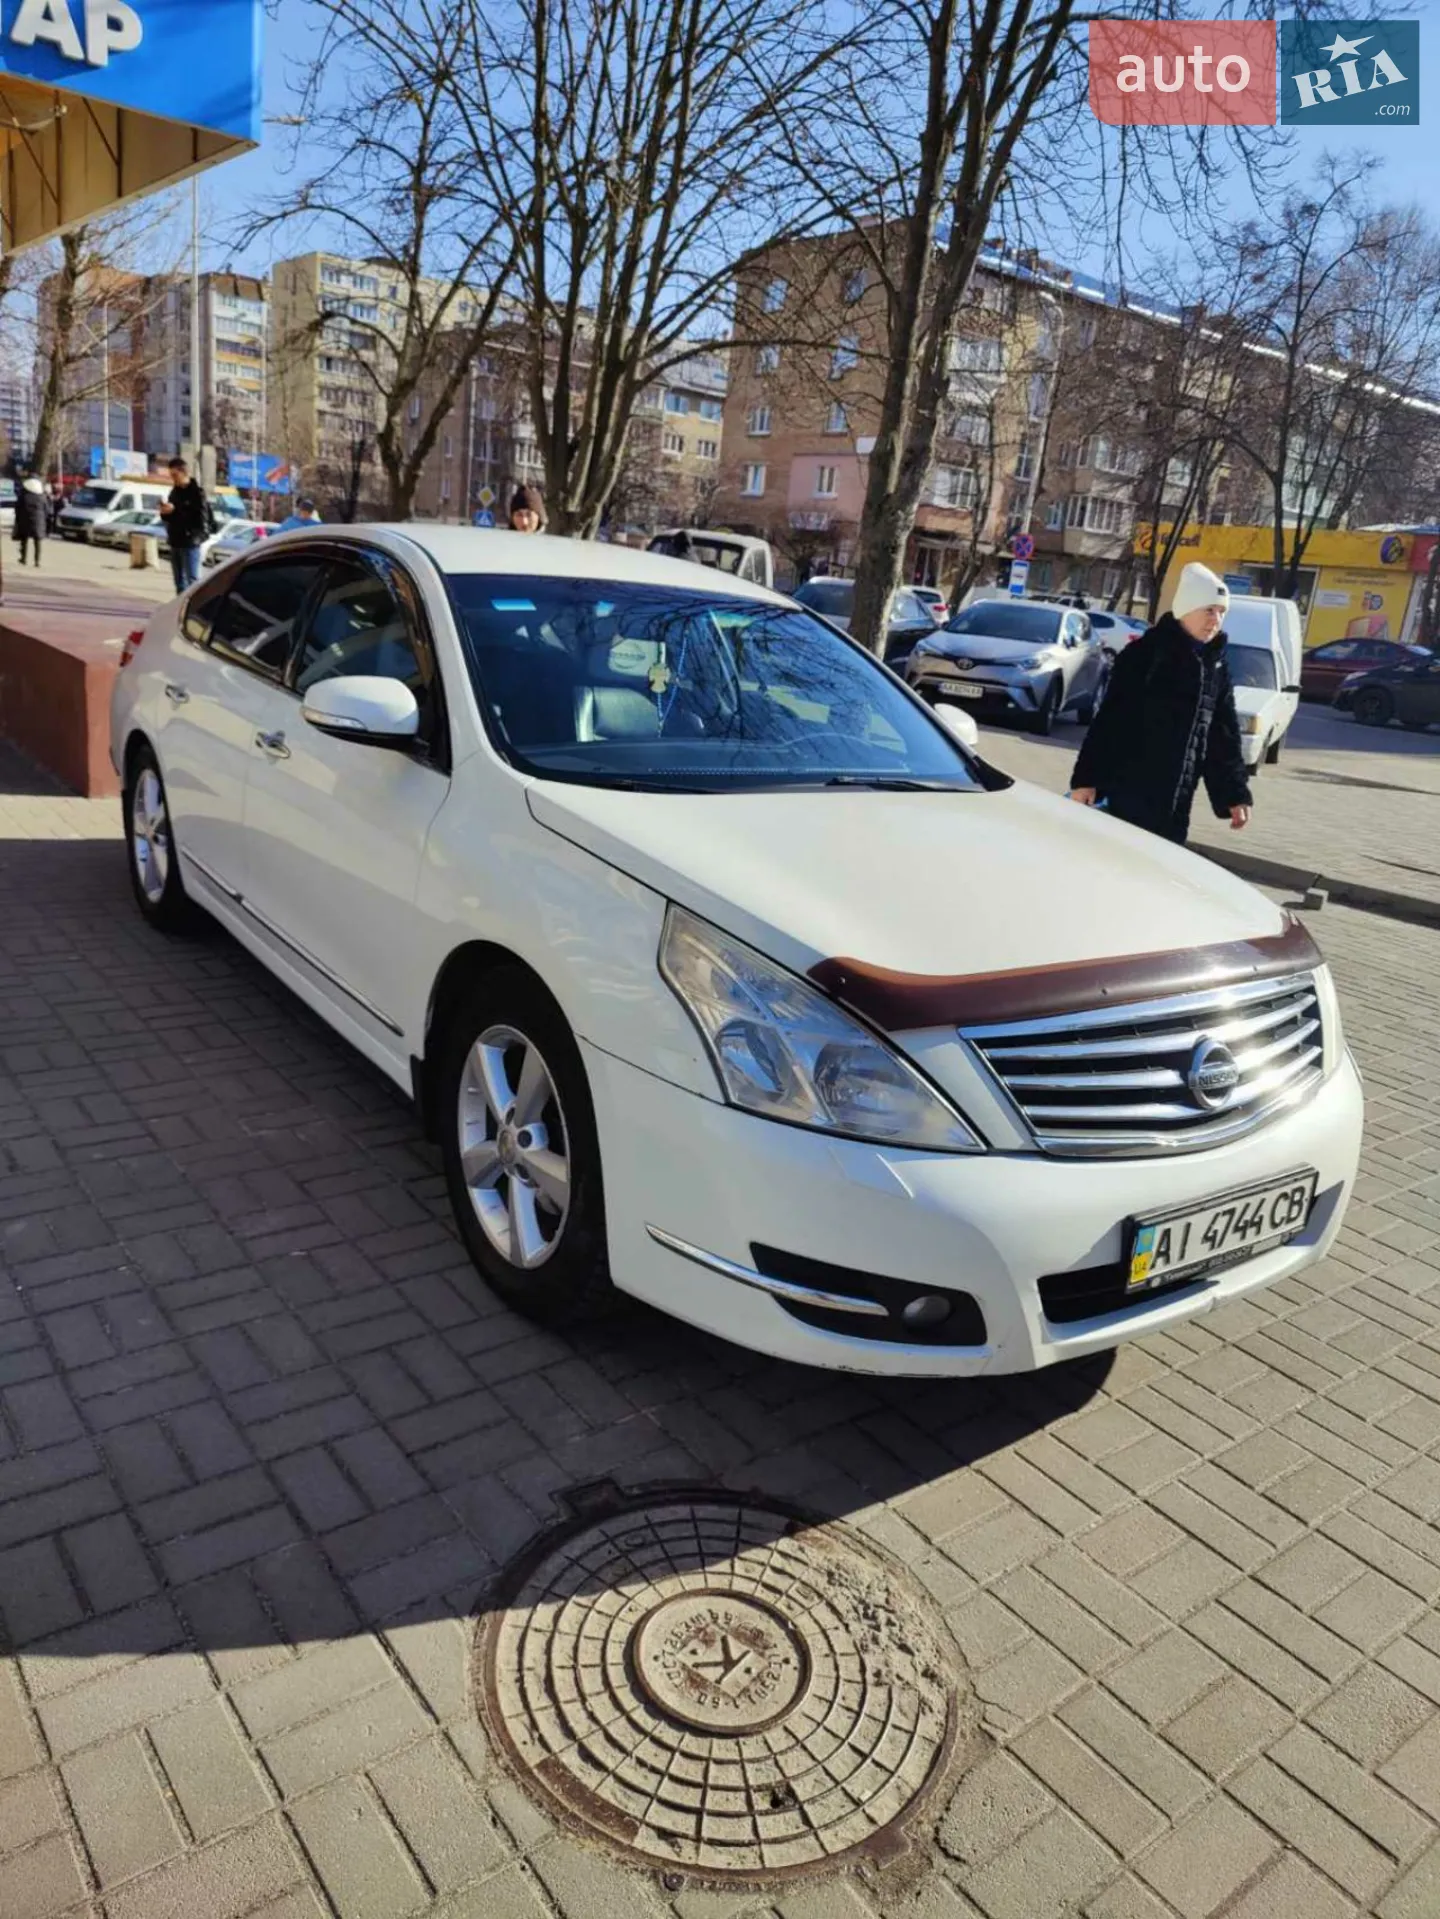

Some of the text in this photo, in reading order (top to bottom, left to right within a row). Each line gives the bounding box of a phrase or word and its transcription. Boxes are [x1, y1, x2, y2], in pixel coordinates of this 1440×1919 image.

[0, 0, 143, 67] АР
[1150, 1222, 1191, 1269] AI
[1201, 1198, 1266, 1252] 4744
[1270, 1185, 1306, 1230] CB
